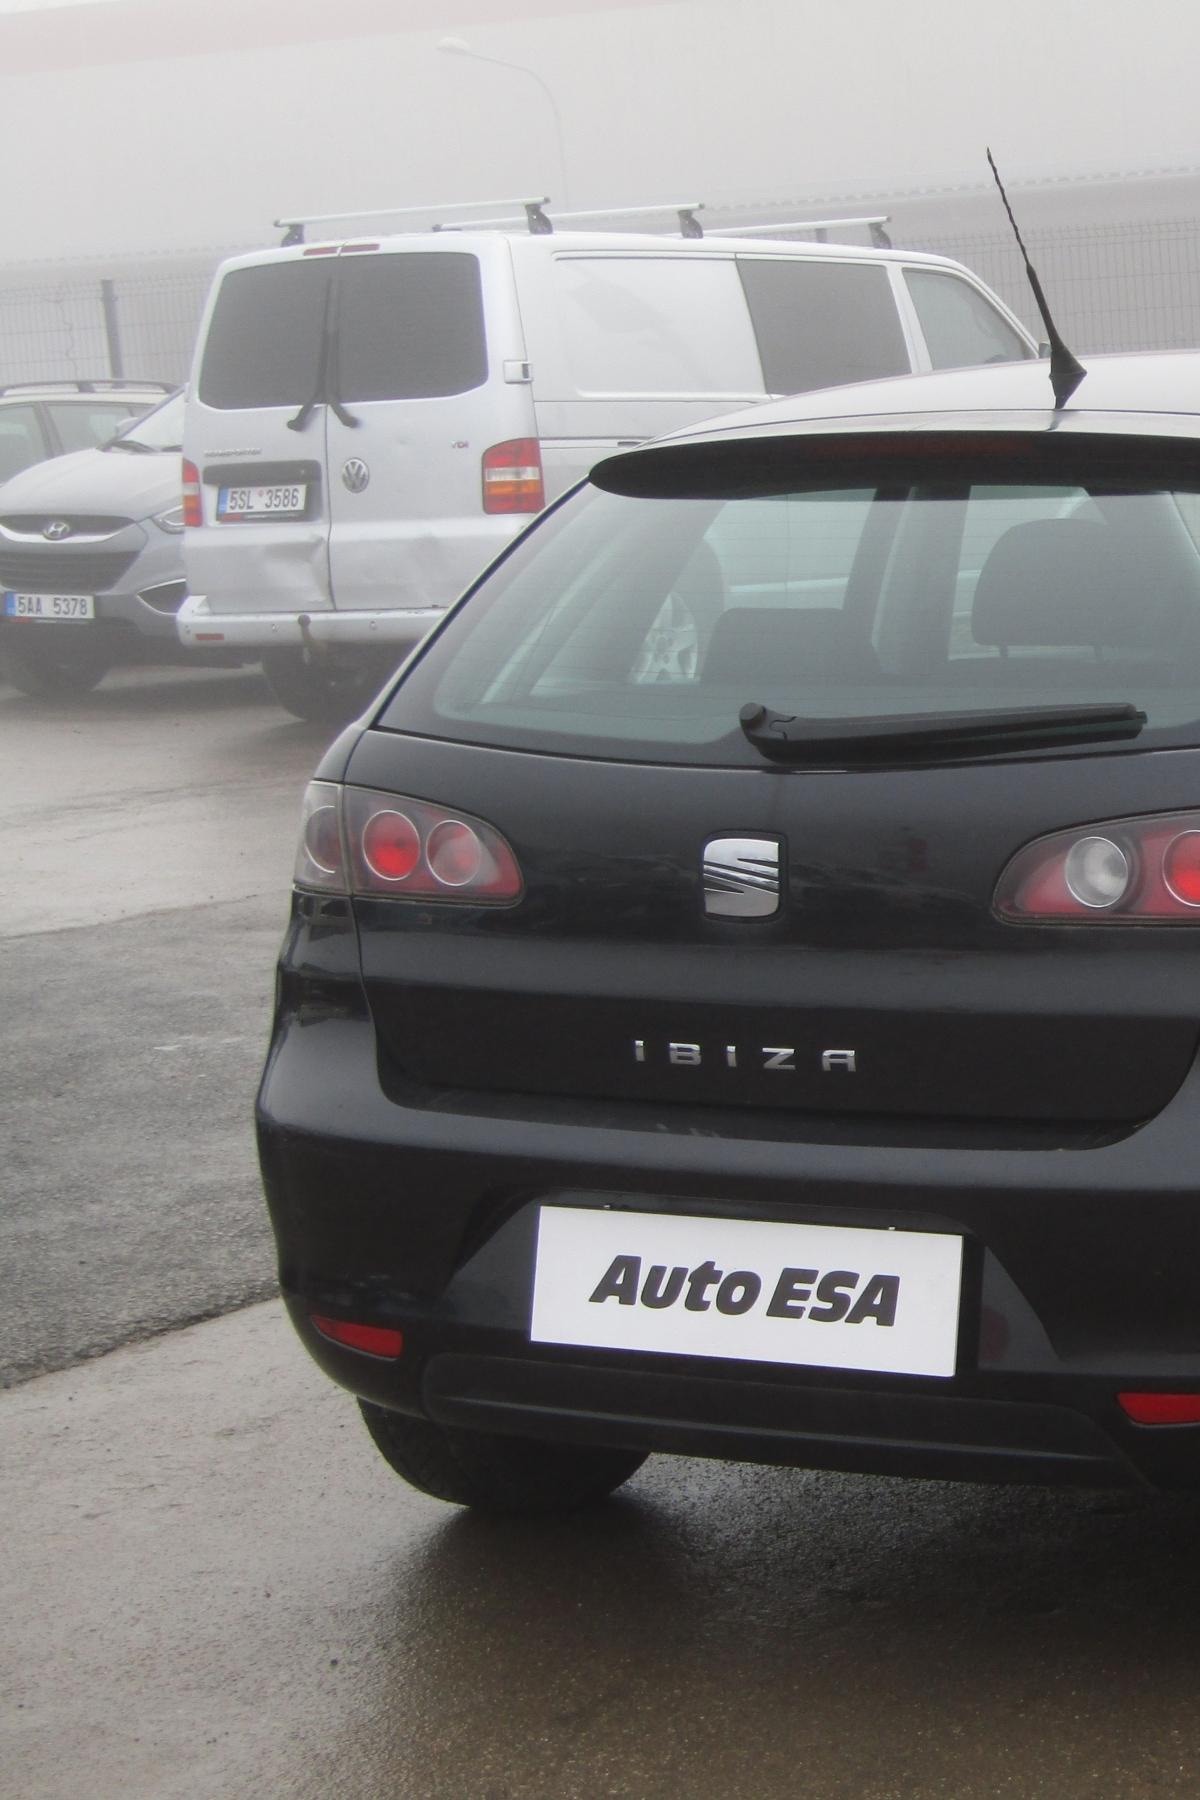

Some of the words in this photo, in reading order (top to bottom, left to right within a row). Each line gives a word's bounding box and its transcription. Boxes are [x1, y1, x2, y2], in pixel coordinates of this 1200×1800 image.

[229, 490, 254, 510] 5SL
[264, 488, 300, 508] 3586
[18, 596, 43, 614] 5AA
[53, 597, 88, 616] 5378
[635, 1040, 857, 1072] IBIZA
[588, 1254, 762, 1316] Auto
[766, 1267, 901, 1327] ESA
